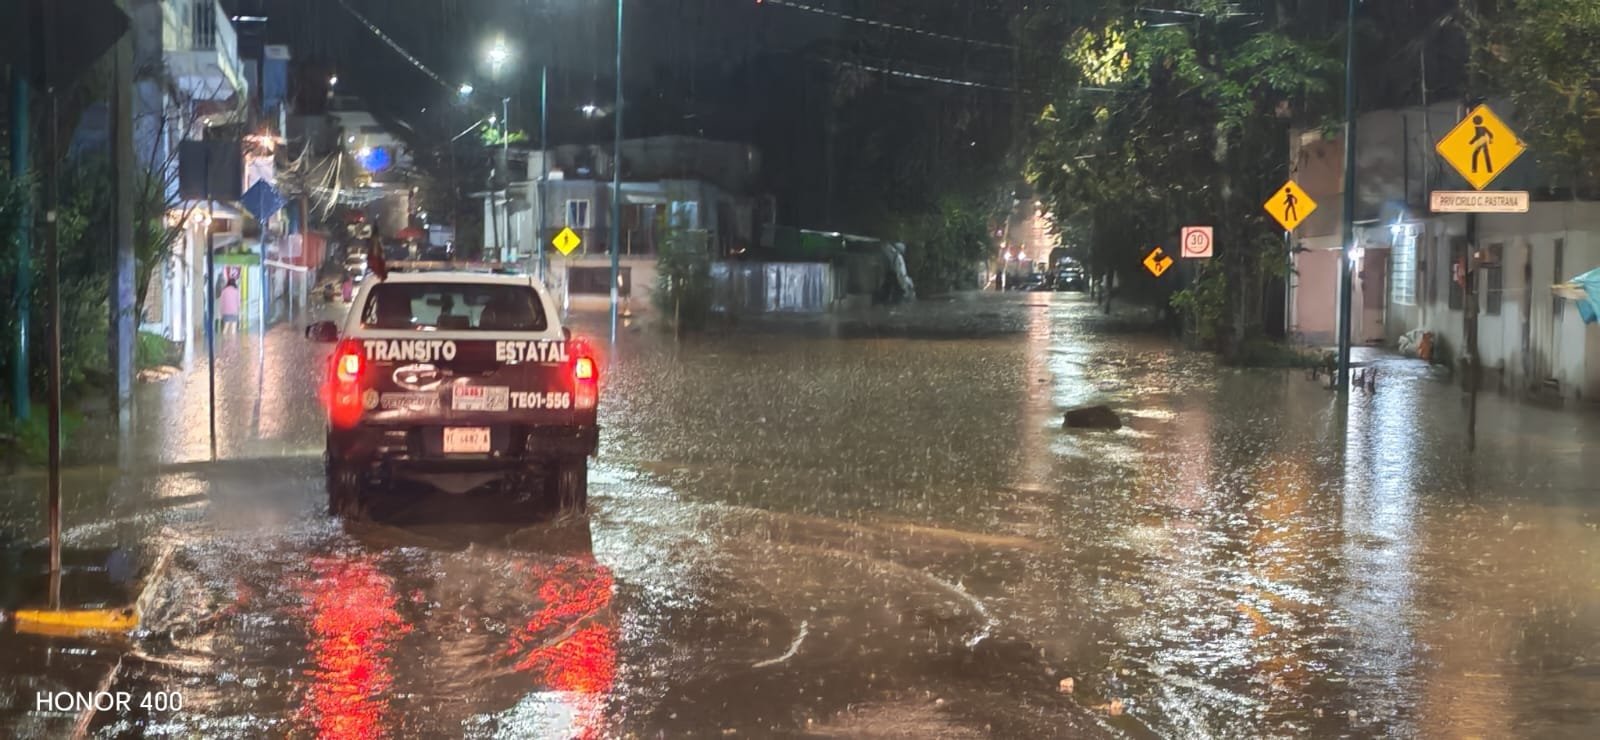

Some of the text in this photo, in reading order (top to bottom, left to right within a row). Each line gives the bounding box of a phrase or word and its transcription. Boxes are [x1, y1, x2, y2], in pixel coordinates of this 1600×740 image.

[1455, 196, 1476, 207] CIRILO
[1485, 195, 1518, 207] PASTRANA
[1191, 234, 1204, 245] 30
[363, 339, 569, 362] TRANSITO ESTATAL
[510, 391, 570, 409] TE01-556
